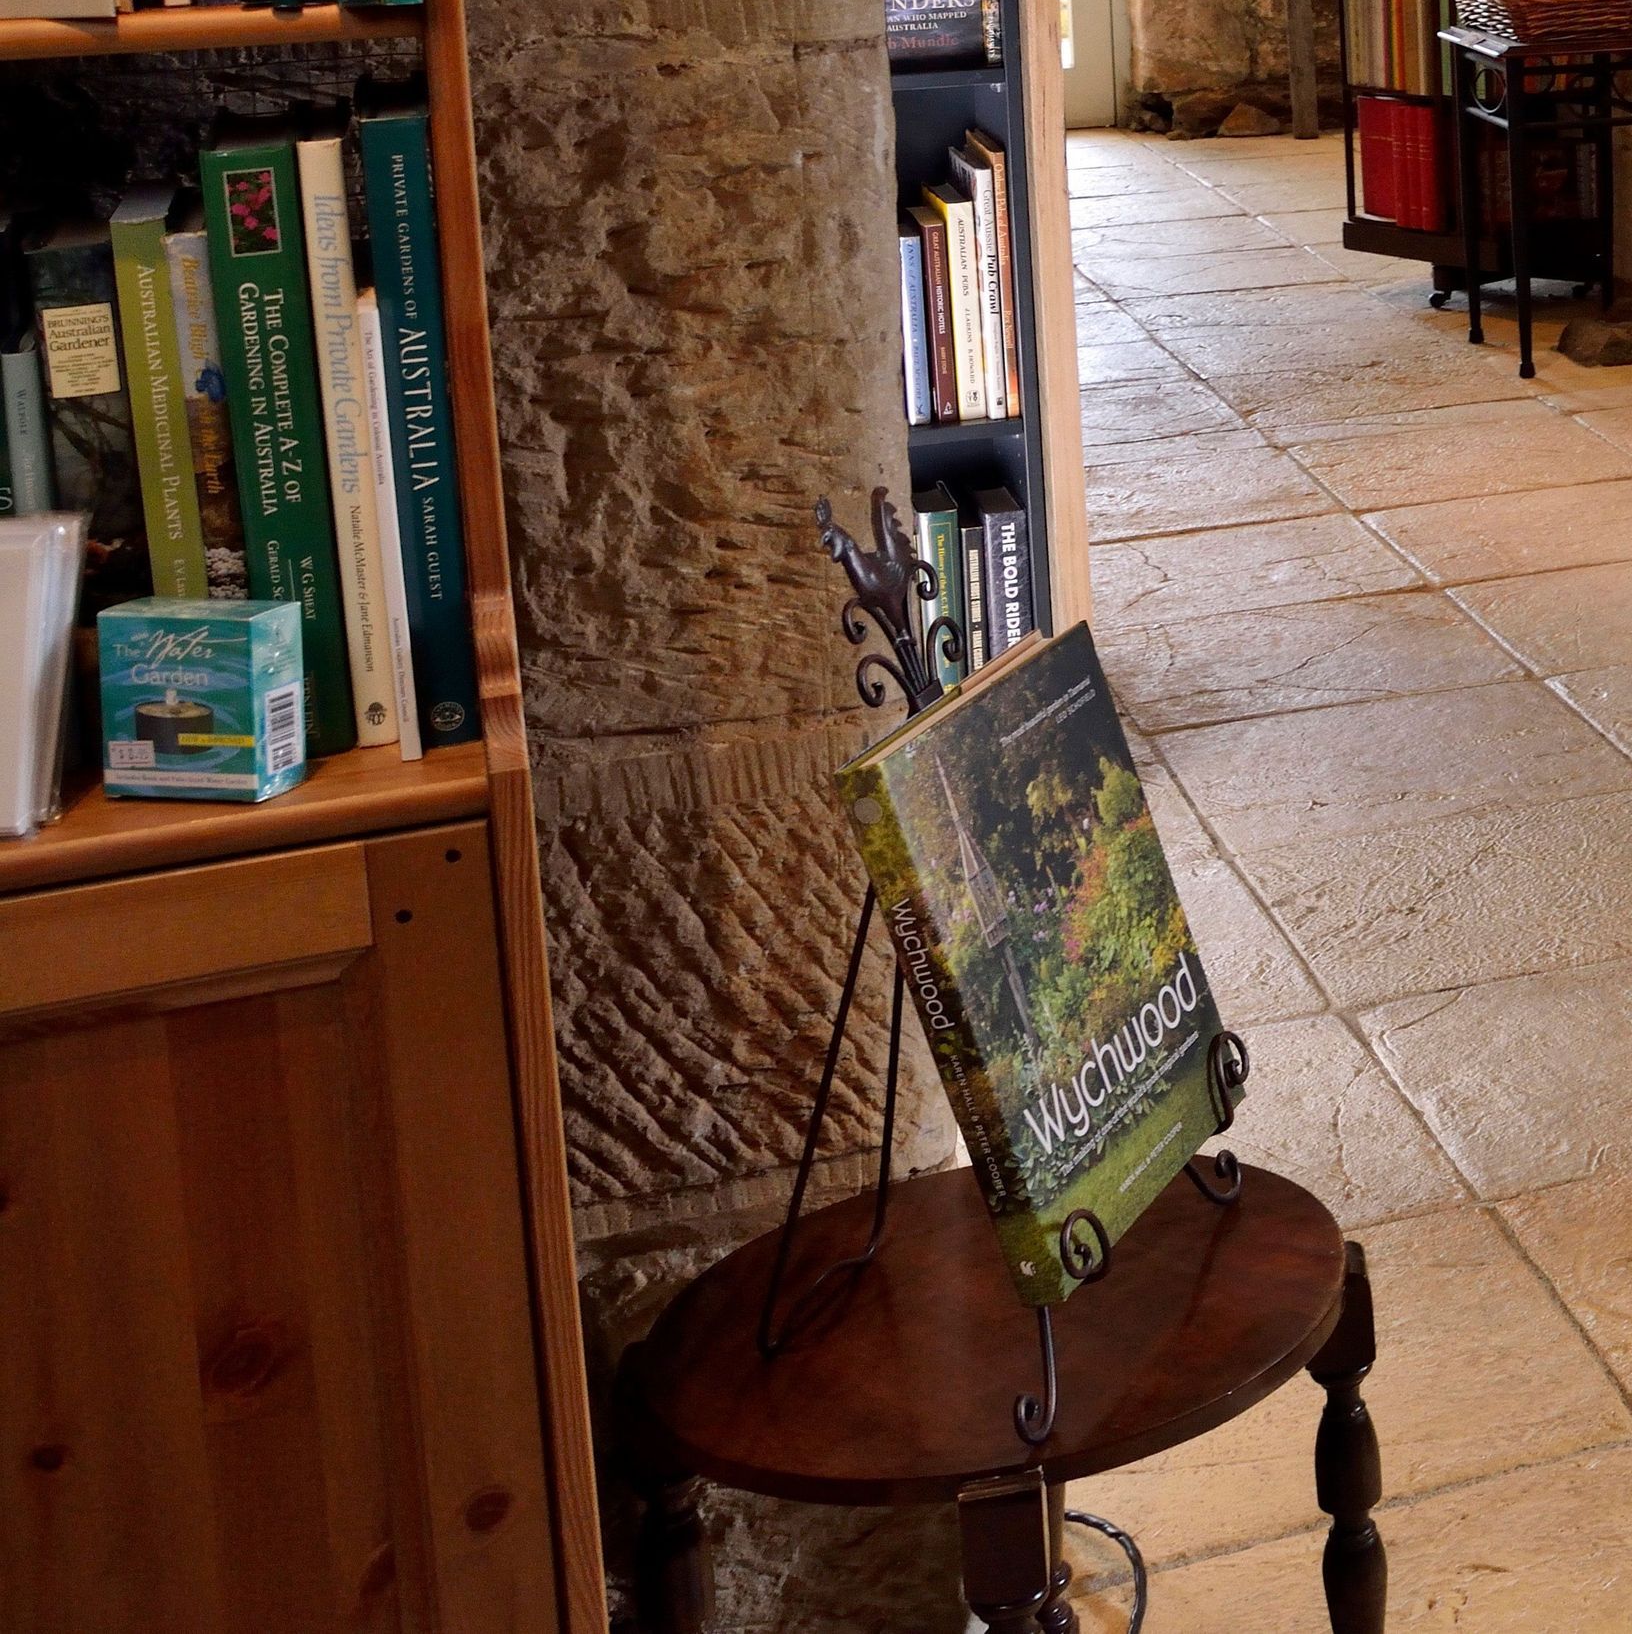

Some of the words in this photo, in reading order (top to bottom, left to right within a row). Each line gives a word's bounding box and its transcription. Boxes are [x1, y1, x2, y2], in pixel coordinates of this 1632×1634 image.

[391, 155, 409, 216] PRIVATE
[982, 189, 990, 216] Great
[312, 193, 346, 249] Ideas
[985, 219, 993, 251] Aussie
[318, 258, 350, 307] from
[398, 223, 414, 295] GARDENS
[987, 255, 996, 277] Pub
[137, 265, 163, 371] AUSTRALIAN
[262, 288, 285, 329] THE
[403, 300, 418, 319] OF
[988, 280, 999, 315] Crawl
[49, 326, 110, 338] Australian
[50, 336, 110, 351] Gardener
[239, 282, 264, 390] GARDENING
[324, 314, 358, 393] Private
[251, 396, 267, 414] IN
[270, 335, 293, 429] COMPLETE
[150, 376, 174, 472] MEDICINAL
[398, 328, 440, 492] AUSTRALIA
[252, 421, 280, 516] AUSTRALIA
[278, 437, 303, 475] A-Z
[334, 399, 368, 494] Gardens
[161, 475, 182, 540] PLANTS
[285, 481, 300, 502] OF
[422, 497, 435, 545] SARAH
[427, 551, 443, 600] GUEST
[132, 664, 209, 685] Garden
[891, 898, 955, 1030] Wychwood
[1024, 952, 1196, 1154] Wychwood
